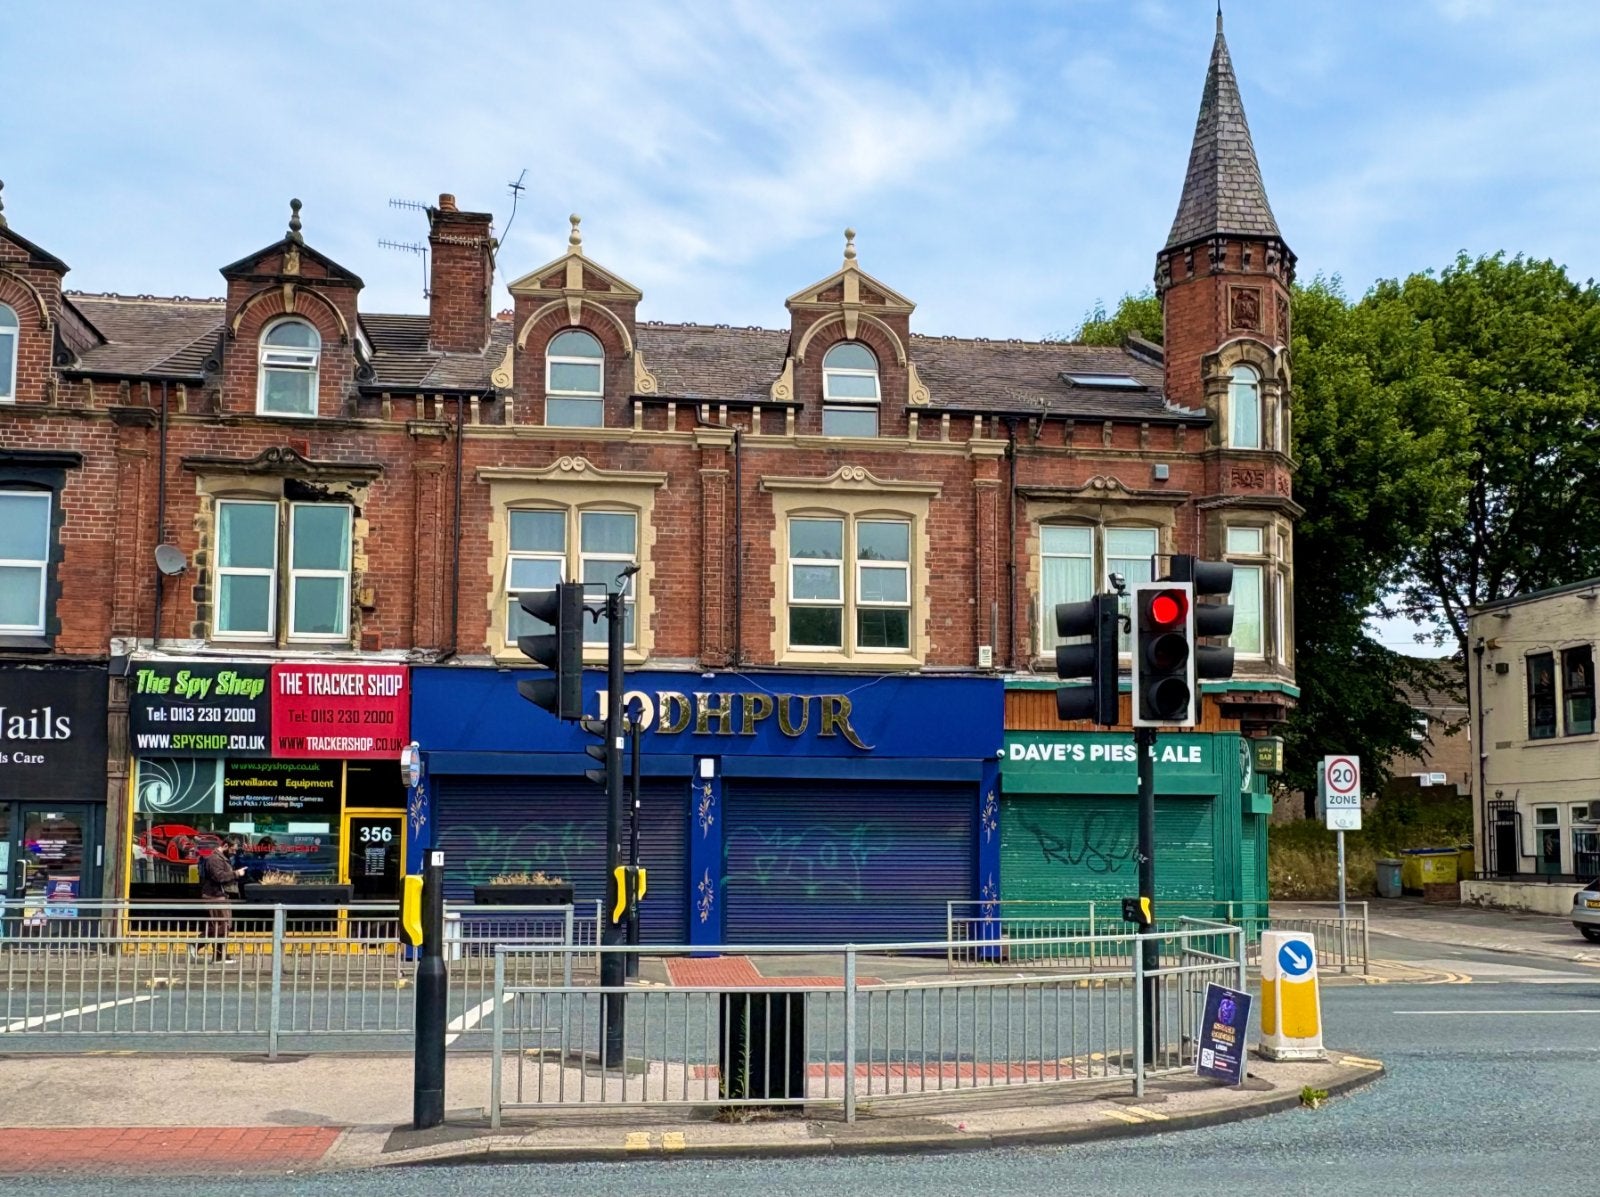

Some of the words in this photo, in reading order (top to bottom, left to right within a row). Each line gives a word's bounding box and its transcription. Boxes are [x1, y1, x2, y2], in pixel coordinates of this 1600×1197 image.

[136, 669, 171, 694] The
[174, 670, 212, 699] Spy
[215, 671, 265, 700] Shop
[278, 673, 303, 695] THE
[306, 673, 364, 696] TRACKER
[368, 674, 403, 696] SHOP
[146, 707, 167, 721] Tel:
[170, 707, 194, 721] 0113
[198, 708, 221, 722] 230
[224, 708, 256, 722] 2000
[311, 709, 334, 724] 0113
[337, 710, 360, 724] 230
[363, 710, 394, 724] 2000
[137, 734, 265, 750] WWW.SPYSHOP.CO.UK
[13, 751, 45, 764] Care
[1009, 743, 1086, 762] DAVE'S
[1090, 744, 1137, 762] PIES
[1161, 745, 1202, 763] ALE
[224, 778, 278, 787] Surveillance
[285, 778, 334, 789] Equipment
[1332, 769, 1353, 783] 20
[1329, 795, 1357, 804] ZONE
[360, 826, 392, 842] 356
